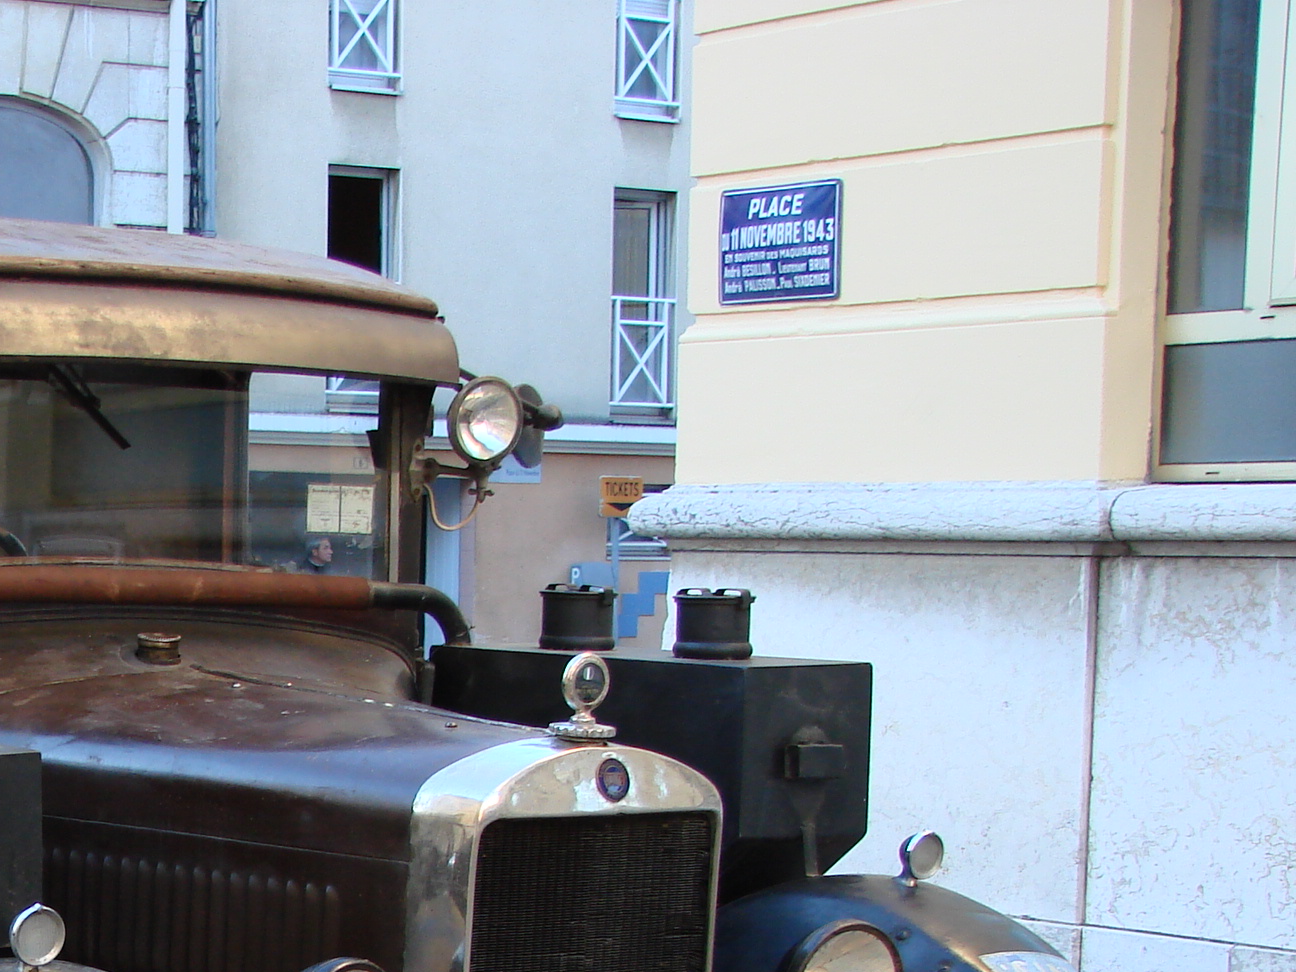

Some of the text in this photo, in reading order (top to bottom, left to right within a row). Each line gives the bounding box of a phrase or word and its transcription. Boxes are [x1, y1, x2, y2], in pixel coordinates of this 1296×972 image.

[748, 194, 804, 219] PLACE
[731, 228, 740, 250] 11
[740, 221, 802, 250] NOVEMBRE
[803, 218, 834, 243] 1943
[605, 481, 640, 498] TICKETS
